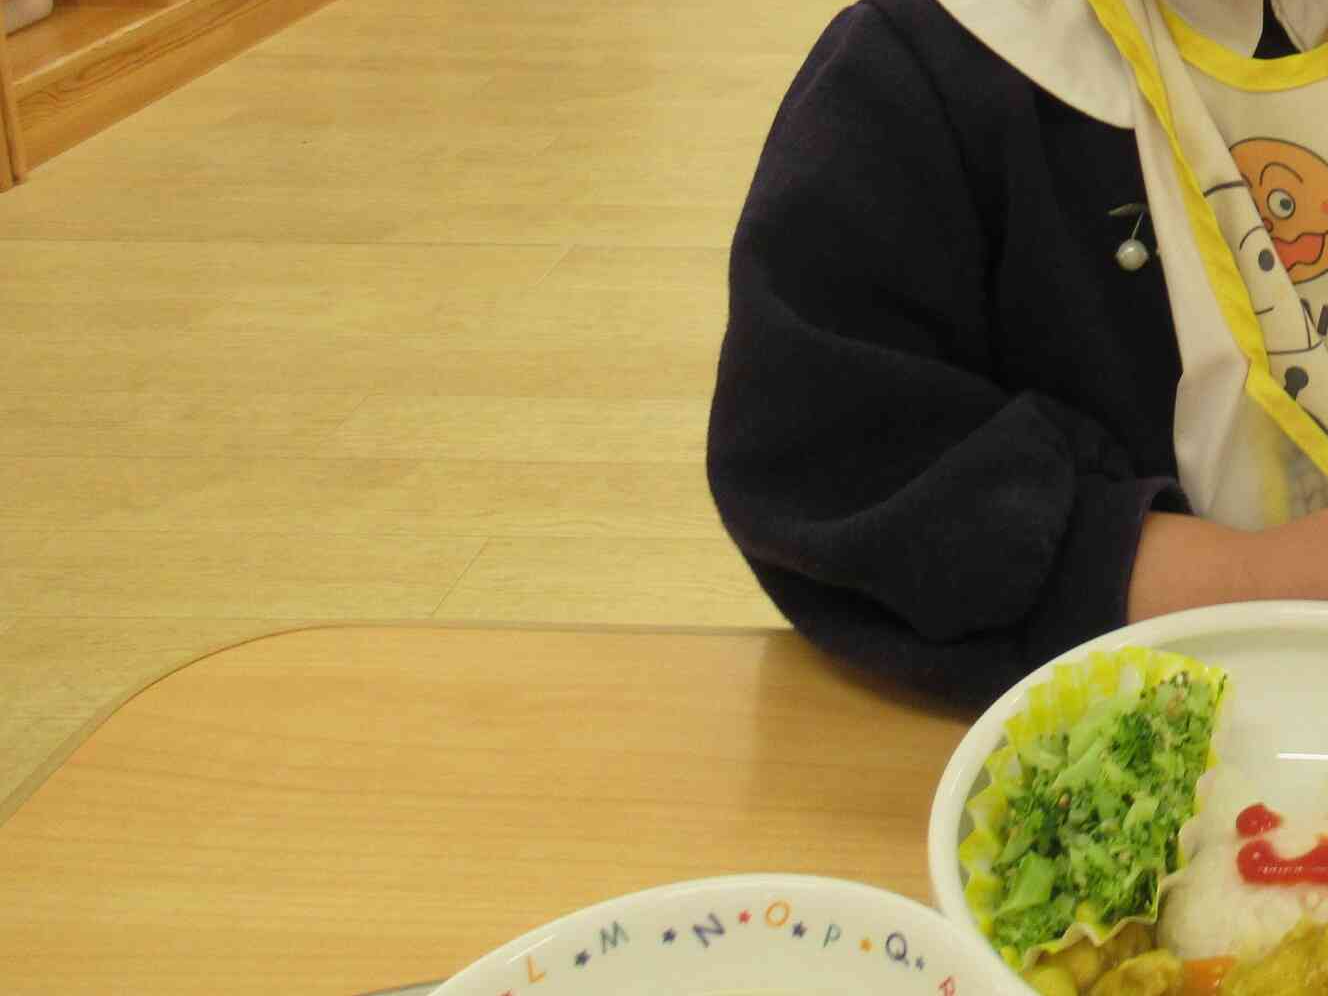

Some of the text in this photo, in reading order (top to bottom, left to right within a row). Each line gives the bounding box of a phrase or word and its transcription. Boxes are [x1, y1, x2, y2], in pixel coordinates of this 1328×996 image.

[526, 955, 546, 984] L
[600, 920, 630, 954] M
[692, 912, 726, 949] N
[765, 901, 791, 928] O
[823, 923, 842, 948] P
[885, 931, 909, 967] Q
